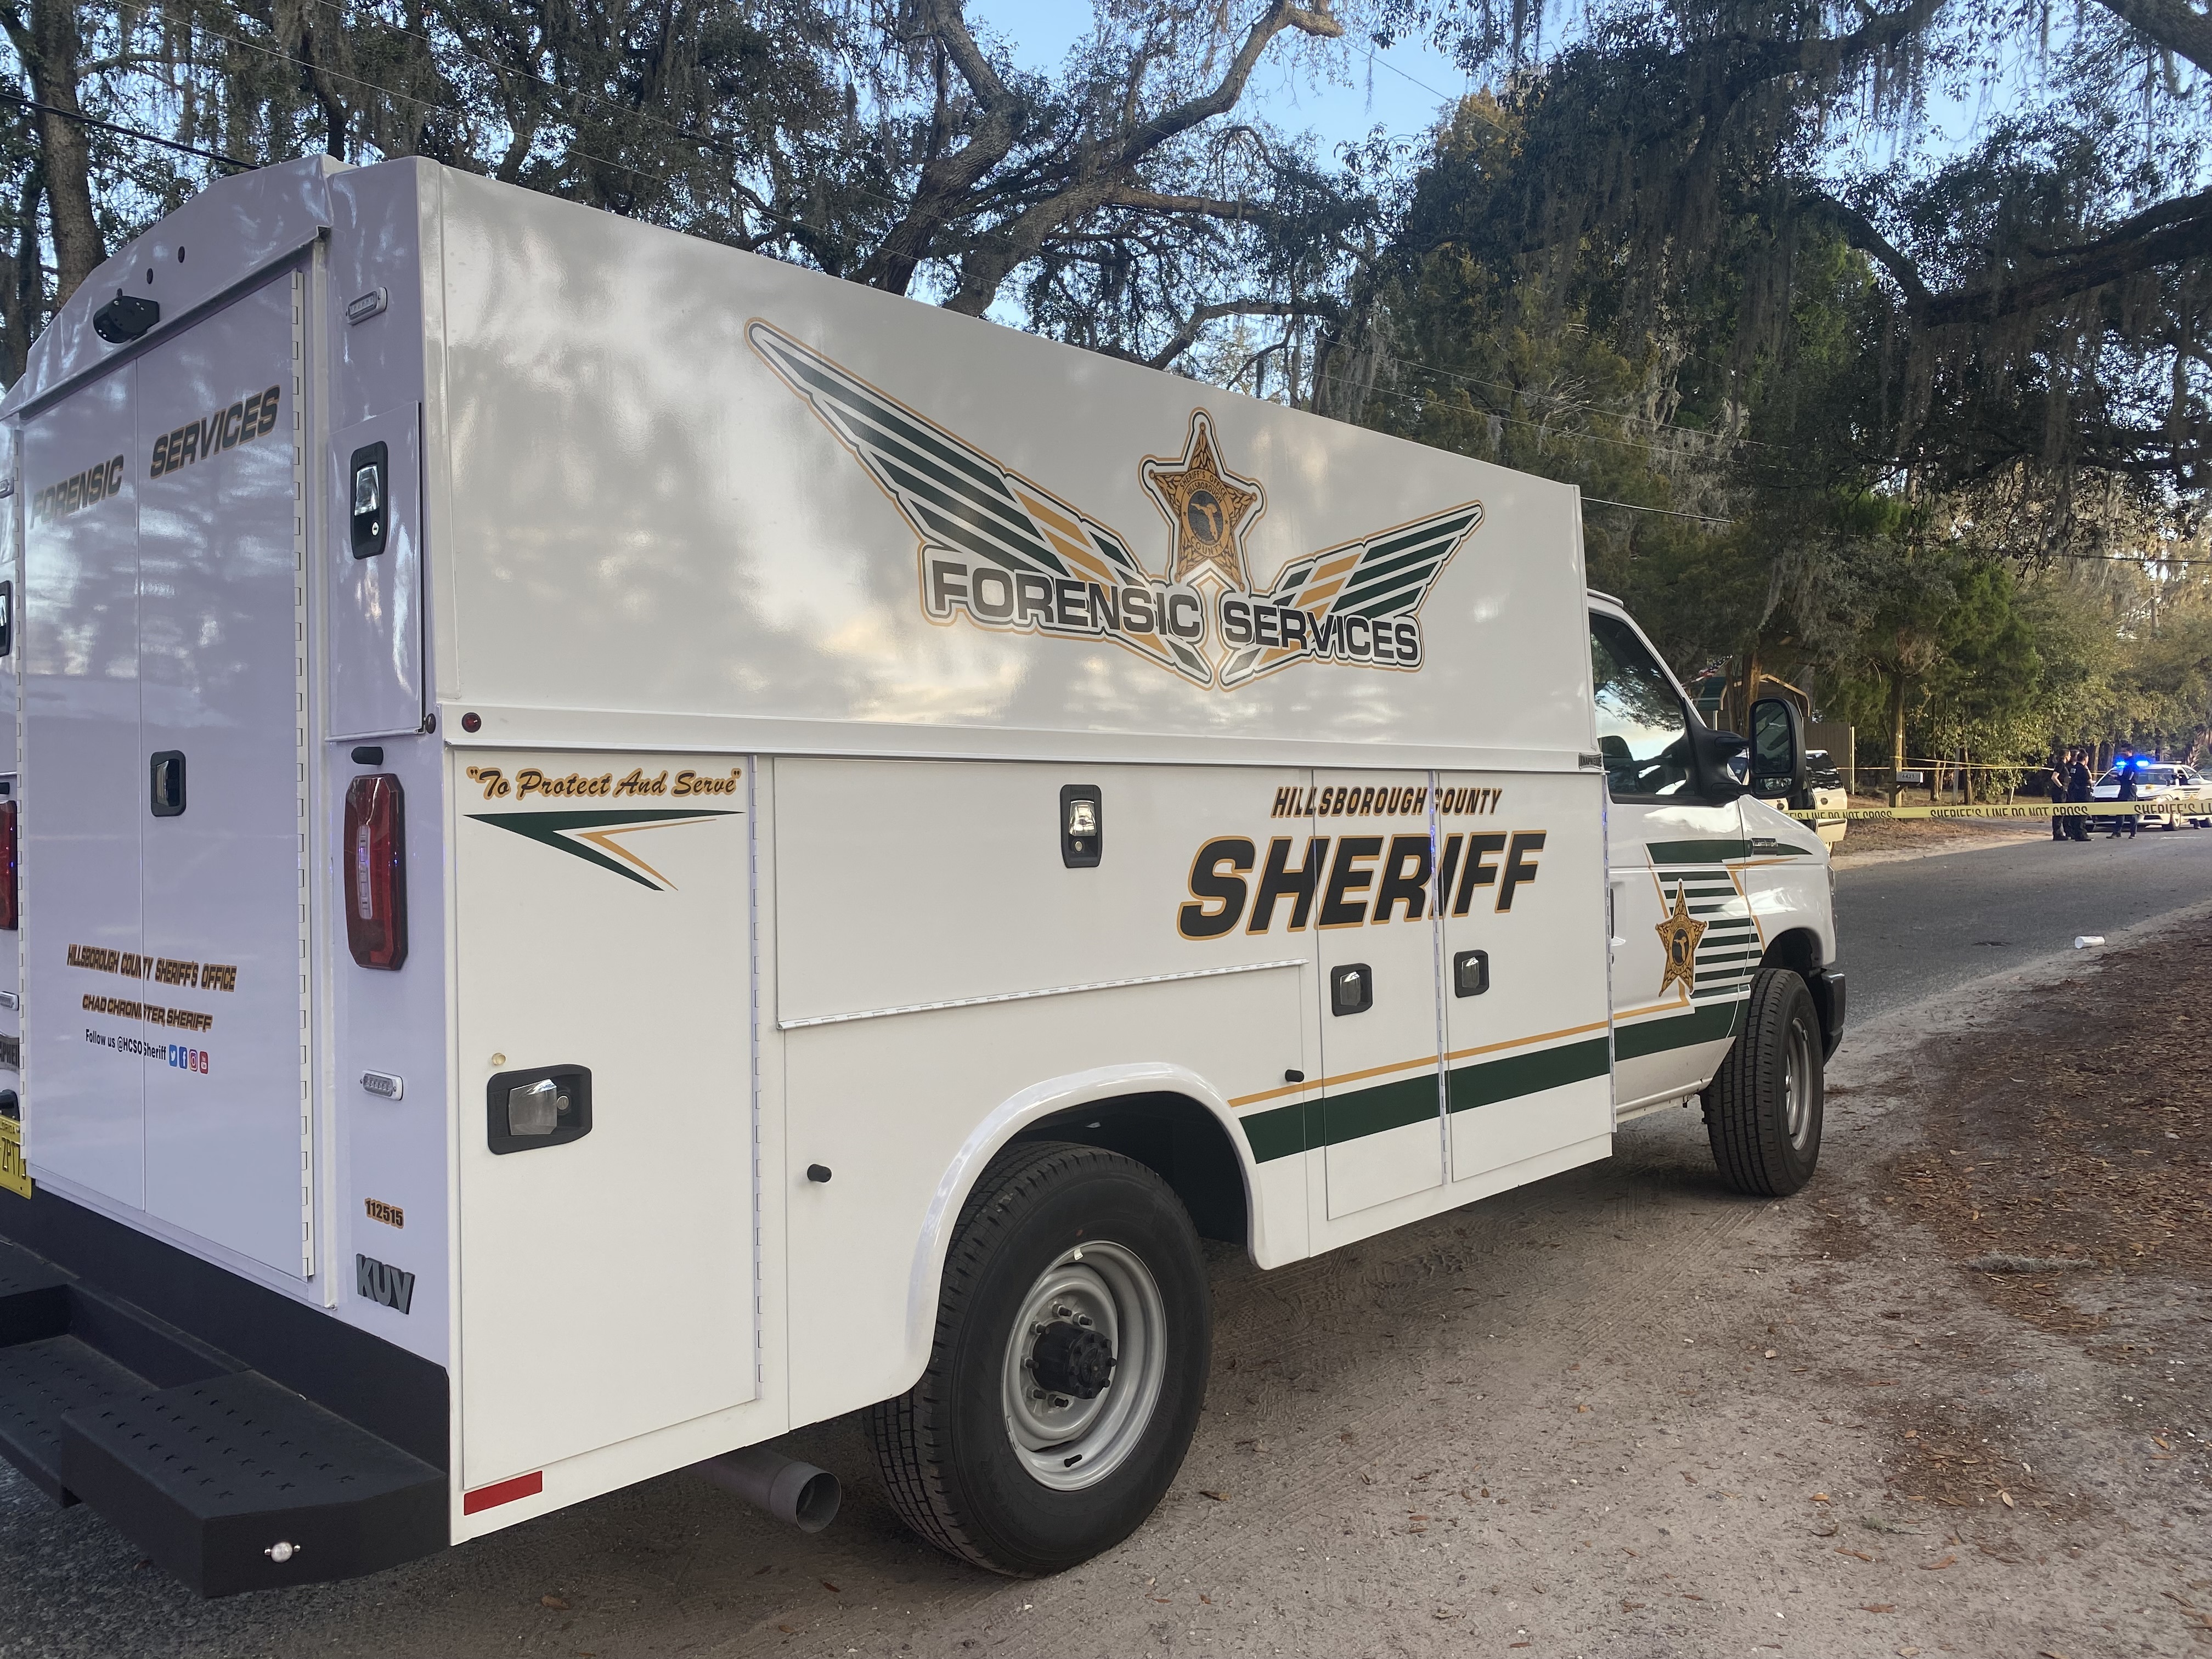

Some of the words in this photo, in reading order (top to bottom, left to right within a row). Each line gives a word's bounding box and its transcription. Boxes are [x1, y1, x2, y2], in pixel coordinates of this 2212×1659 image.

[30, 454, 124, 529] FORENSIC
[150, 385, 280, 479] SERVICES
[1180, 470, 1205, 490] SHERIFF'S
[1210, 475, 1228, 498] OFFICE
[1186, 482, 1223, 504] HILLSBOROUGH
[1191, 536, 1223, 555] COUNTY
[931, 560, 1201, 637] FORENSIC
[1224, 600, 1418, 661] SERVICES
[468, 768, 511, 799] "To
[516, 768, 612, 800] Protect
[612, 768, 668, 798] And
[671, 768, 741, 798] Serve"
[1271, 786, 1427, 818] HILLSBOROUGH
[1177, 830, 1547, 941] SHERIFF
[67, 944, 120, 974] HILLSBOROUGH
[121, 952, 154, 981] COUNTY
[155, 957, 199, 988] SHERIFF'S
[201, 963, 237, 992] OFFICE
[82, 994, 107, 1013] CHAD
[167, 1008, 213, 1032] SHERIFF
[86, 1029, 106, 1046] Follow
[108, 1037, 115, 1048] us
[365, 1198, 404, 1228] 112515
[356, 1253, 415, 1314] KUV
